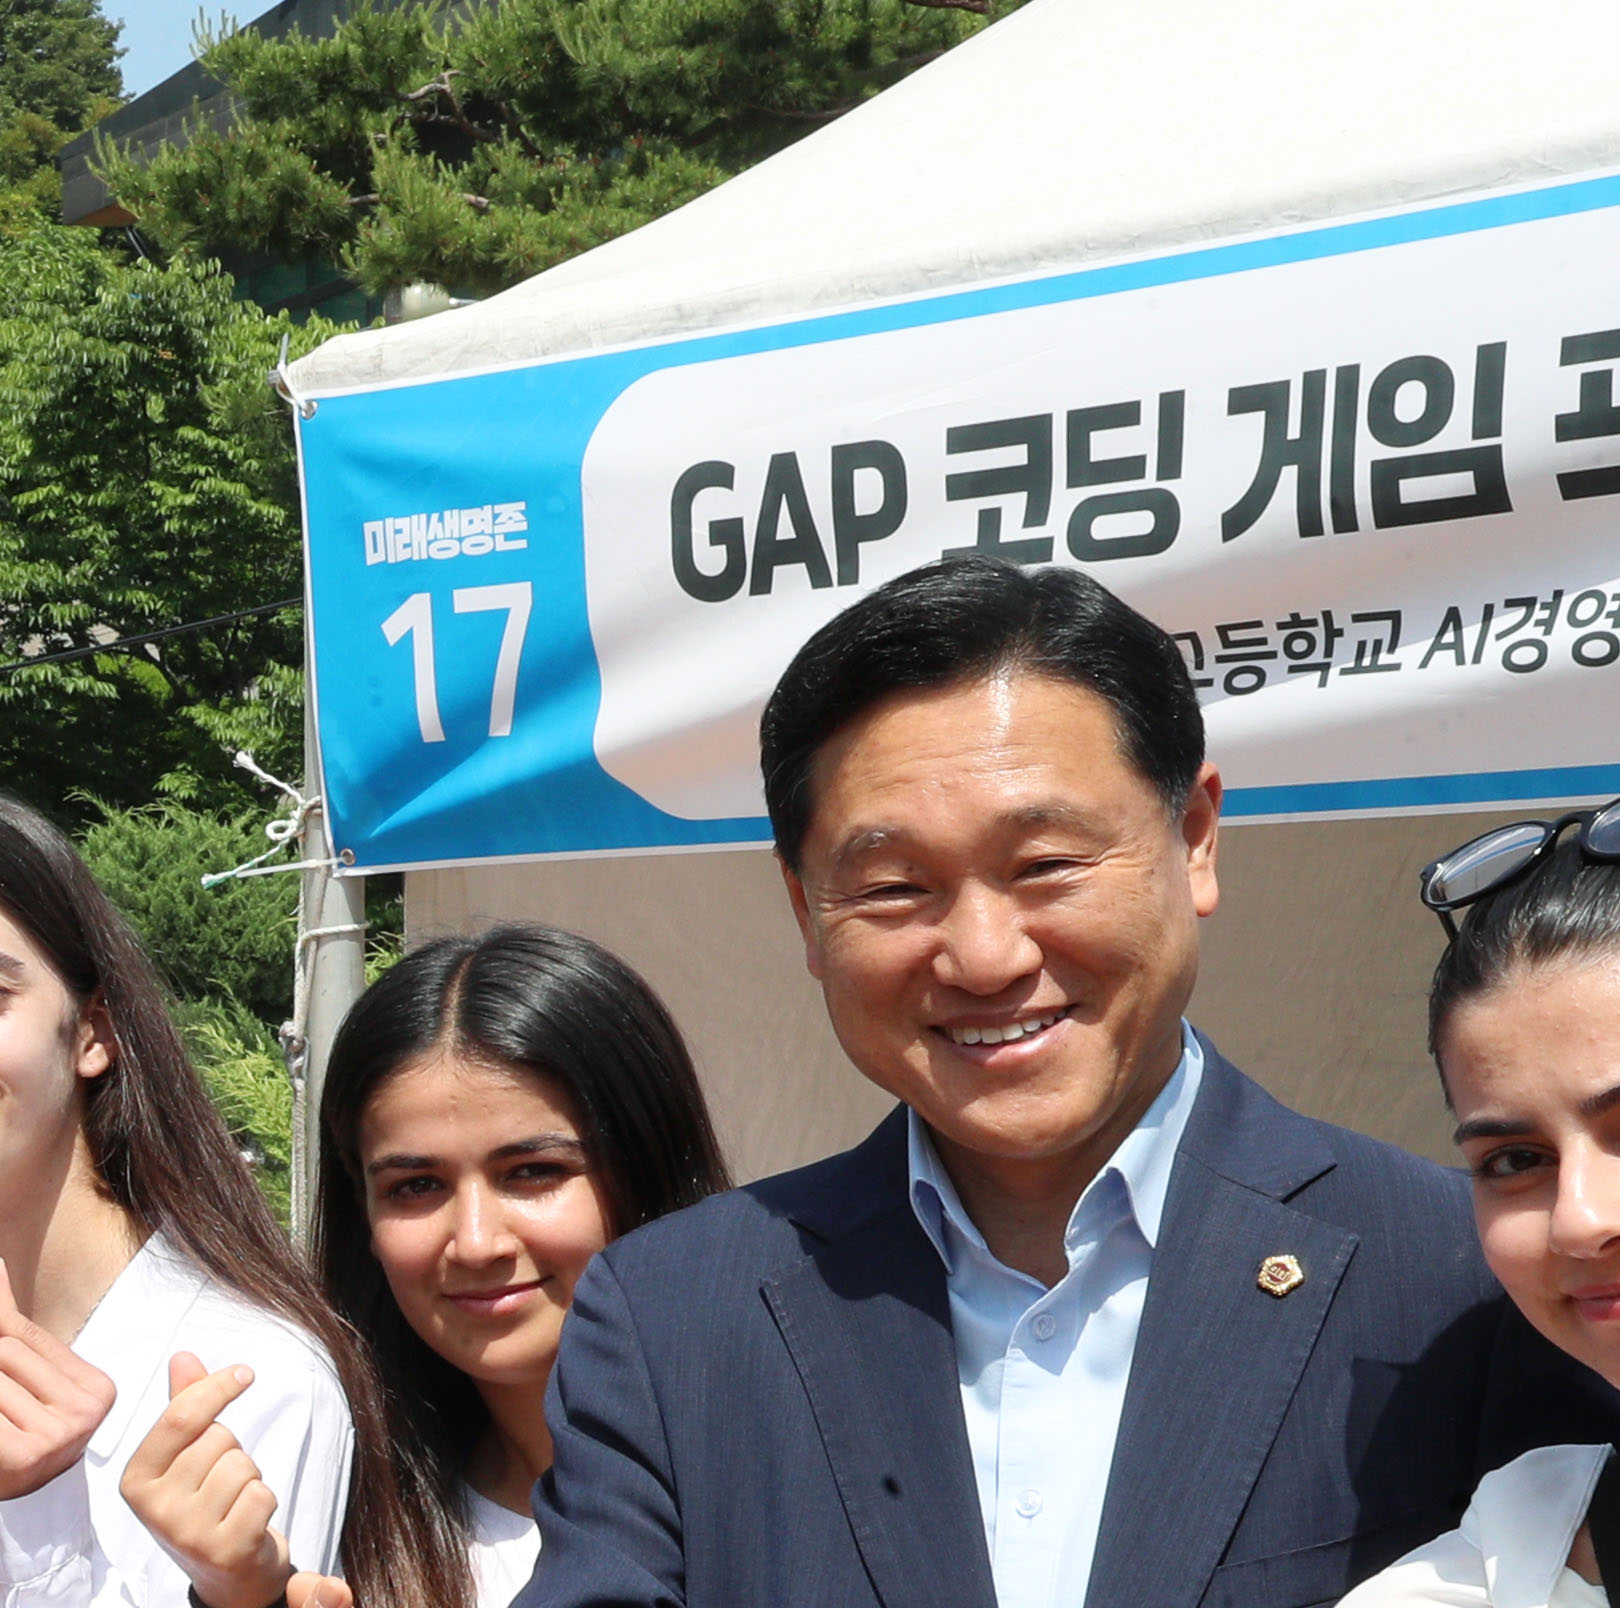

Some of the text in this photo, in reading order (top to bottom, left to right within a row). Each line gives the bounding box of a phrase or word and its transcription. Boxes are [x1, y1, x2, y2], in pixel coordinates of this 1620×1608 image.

[363, 500, 528, 567] 미래생명존
[670, 438, 908, 603] GAP
[941, 387, 1185, 564] 코딩
[1221, 340, 1513, 543] 게임
[380, 581, 533, 743] 17
